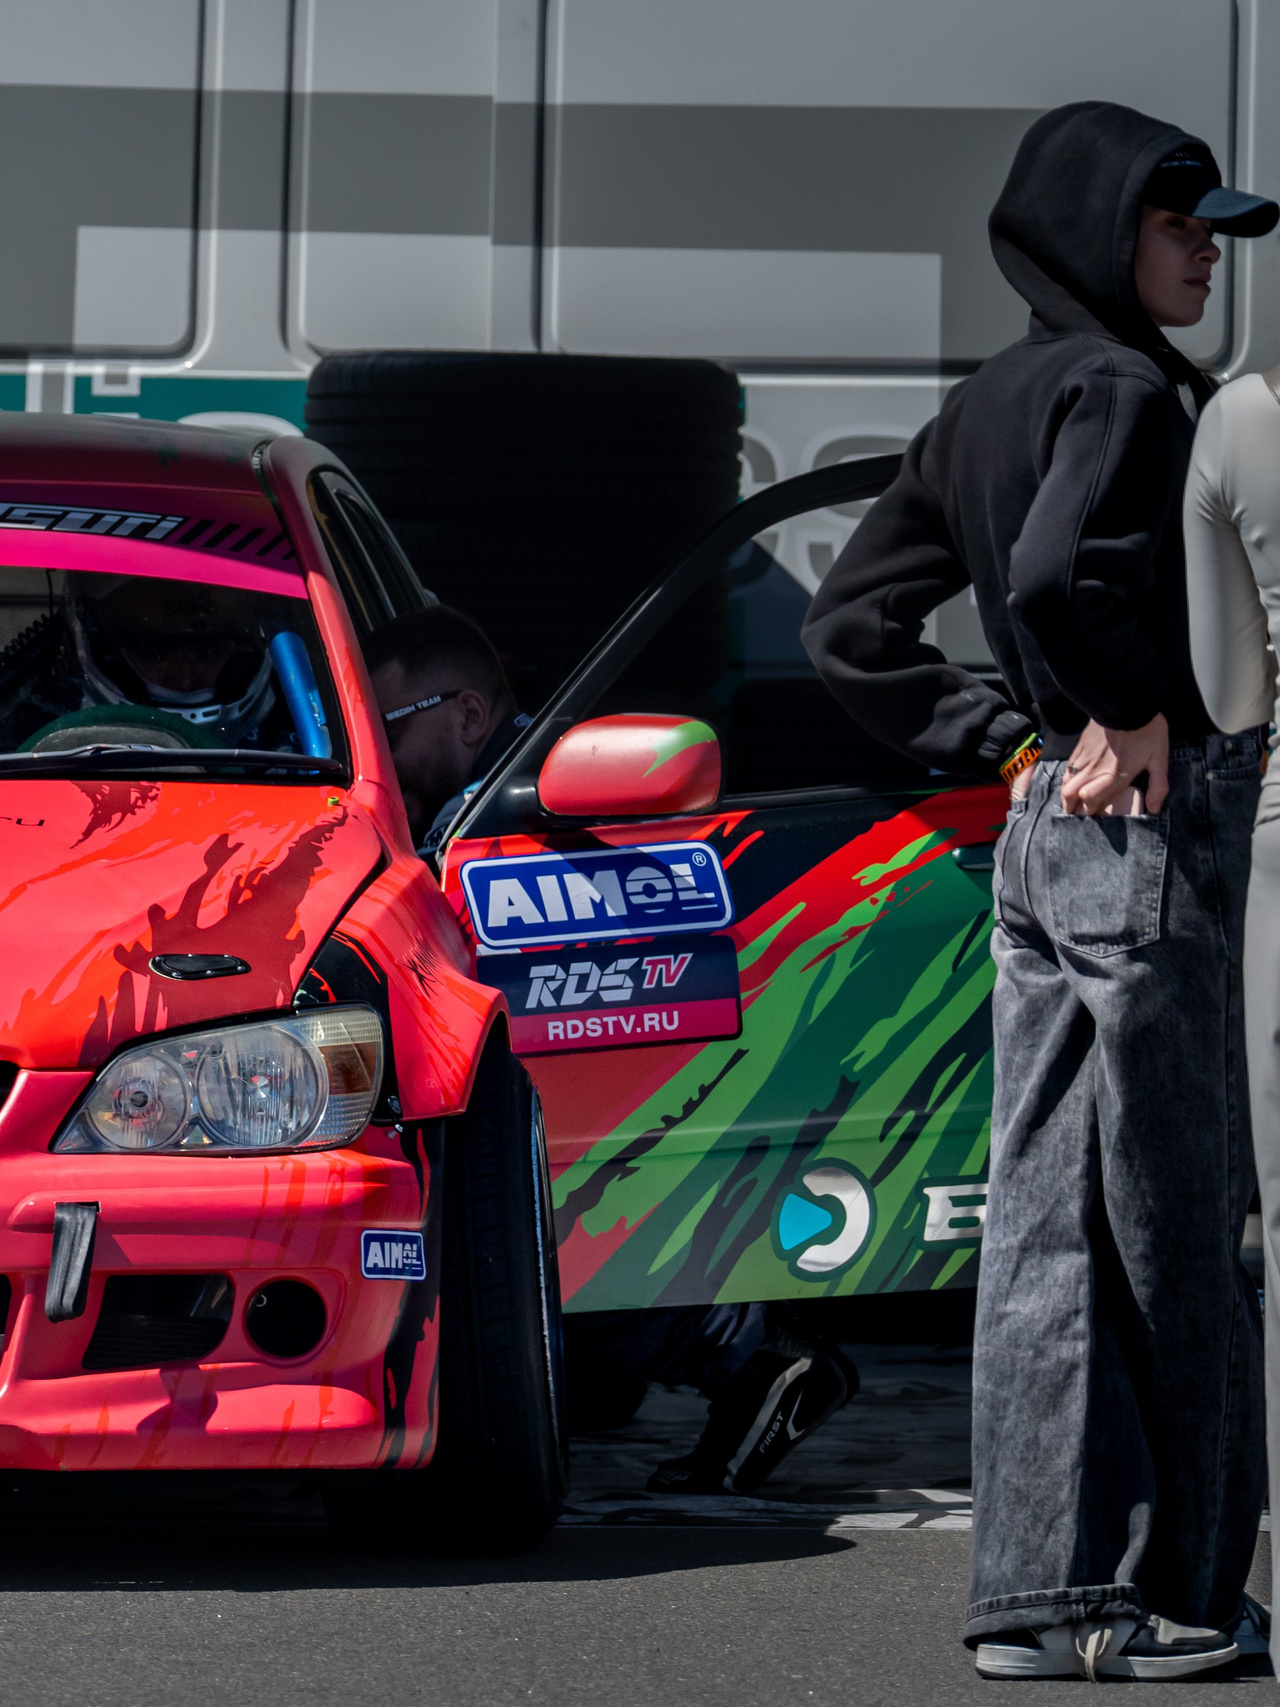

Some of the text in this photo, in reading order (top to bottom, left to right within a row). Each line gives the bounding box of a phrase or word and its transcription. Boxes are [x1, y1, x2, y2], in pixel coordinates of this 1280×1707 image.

[415, 695, 442, 709] TEAM
[487, 863, 718, 928] AIMOL
[525, 953, 694, 1009] RDS TV
[547, 1010, 680, 1041] RDSTV.RU
[366, 1241, 422, 1270] AIMOL
[759, 1410, 784, 1454] FIRST
